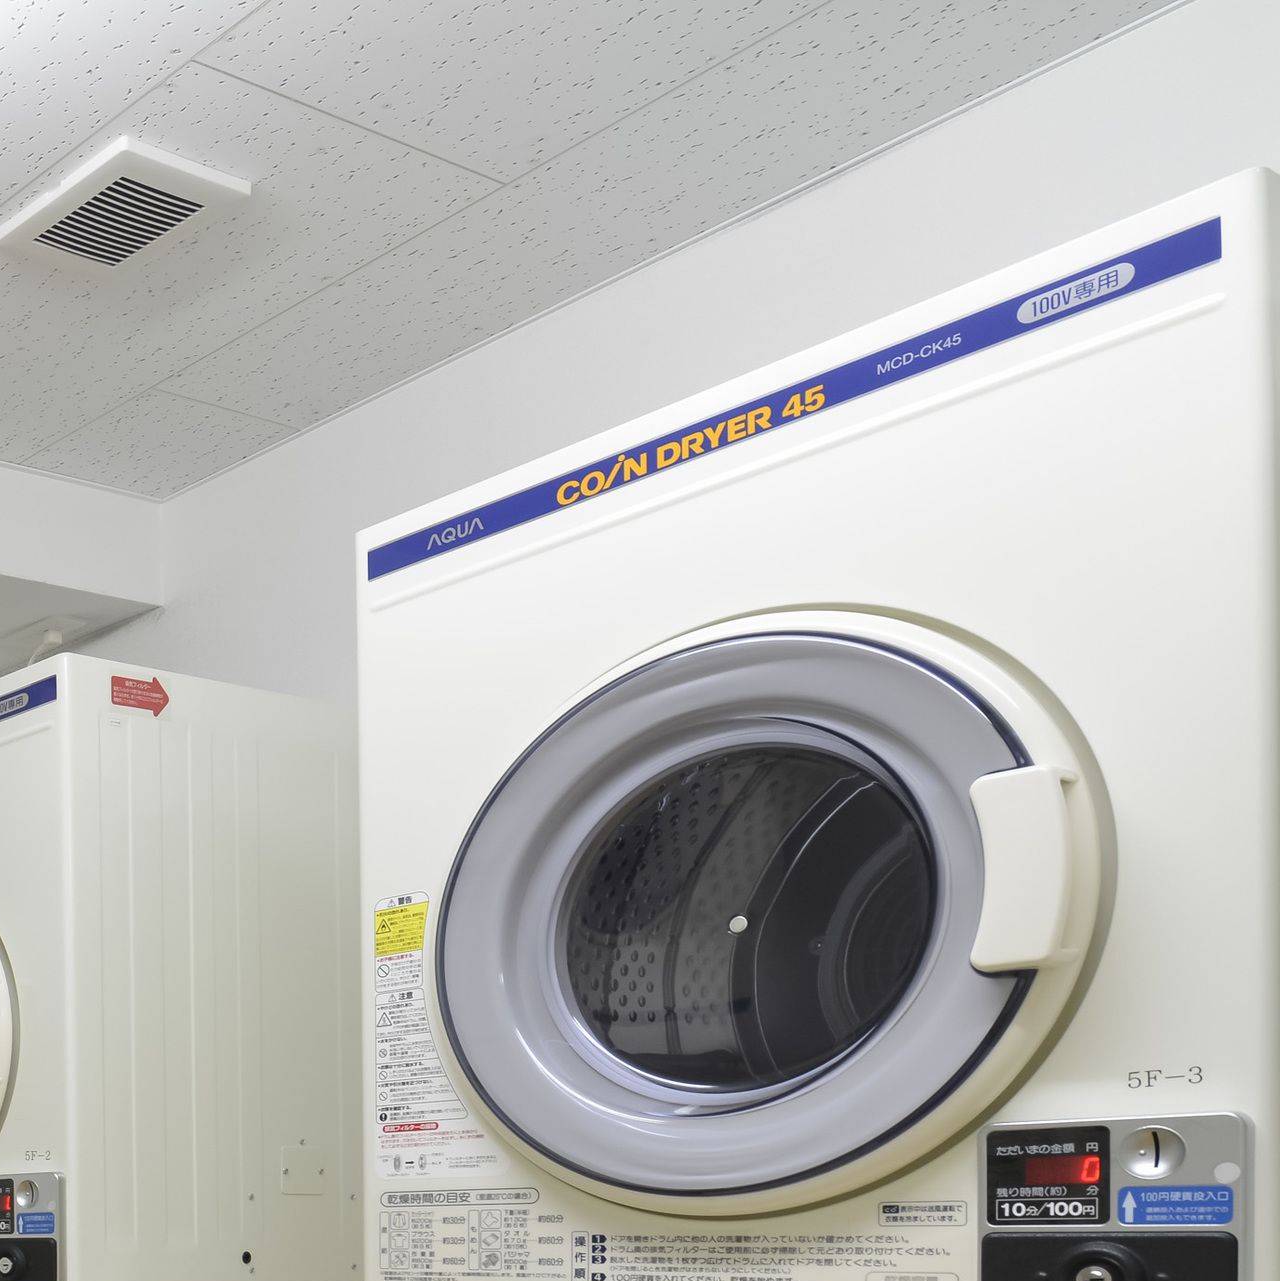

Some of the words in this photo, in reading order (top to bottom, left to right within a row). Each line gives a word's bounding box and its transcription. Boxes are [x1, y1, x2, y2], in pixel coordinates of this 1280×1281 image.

[1031, 268, 1120, 318] 100V専用
[877, 333, 963, 376] MCD-CK45
[556, 453, 648, 506] COIN
[656, 405, 772, 470] DRYER
[782, 384, 827, 419] 45
[427, 517, 485, 551] AQUA
[398, 991, 413, 1001] 注意
[996, 1143, 1075, 1156] ただいまの金額
[1086, 1142, 1099, 1153] 円
[1080, 1156, 1101, 1183] 0
[387, 1192, 471, 1205] 乾燥時間の目安
[1086, 1186, 1100, 1196] 分
[1140, 1190, 1229, 1202] 100円硬貨投入口
[1000, 1201, 1096, 1217] 10分/100円
